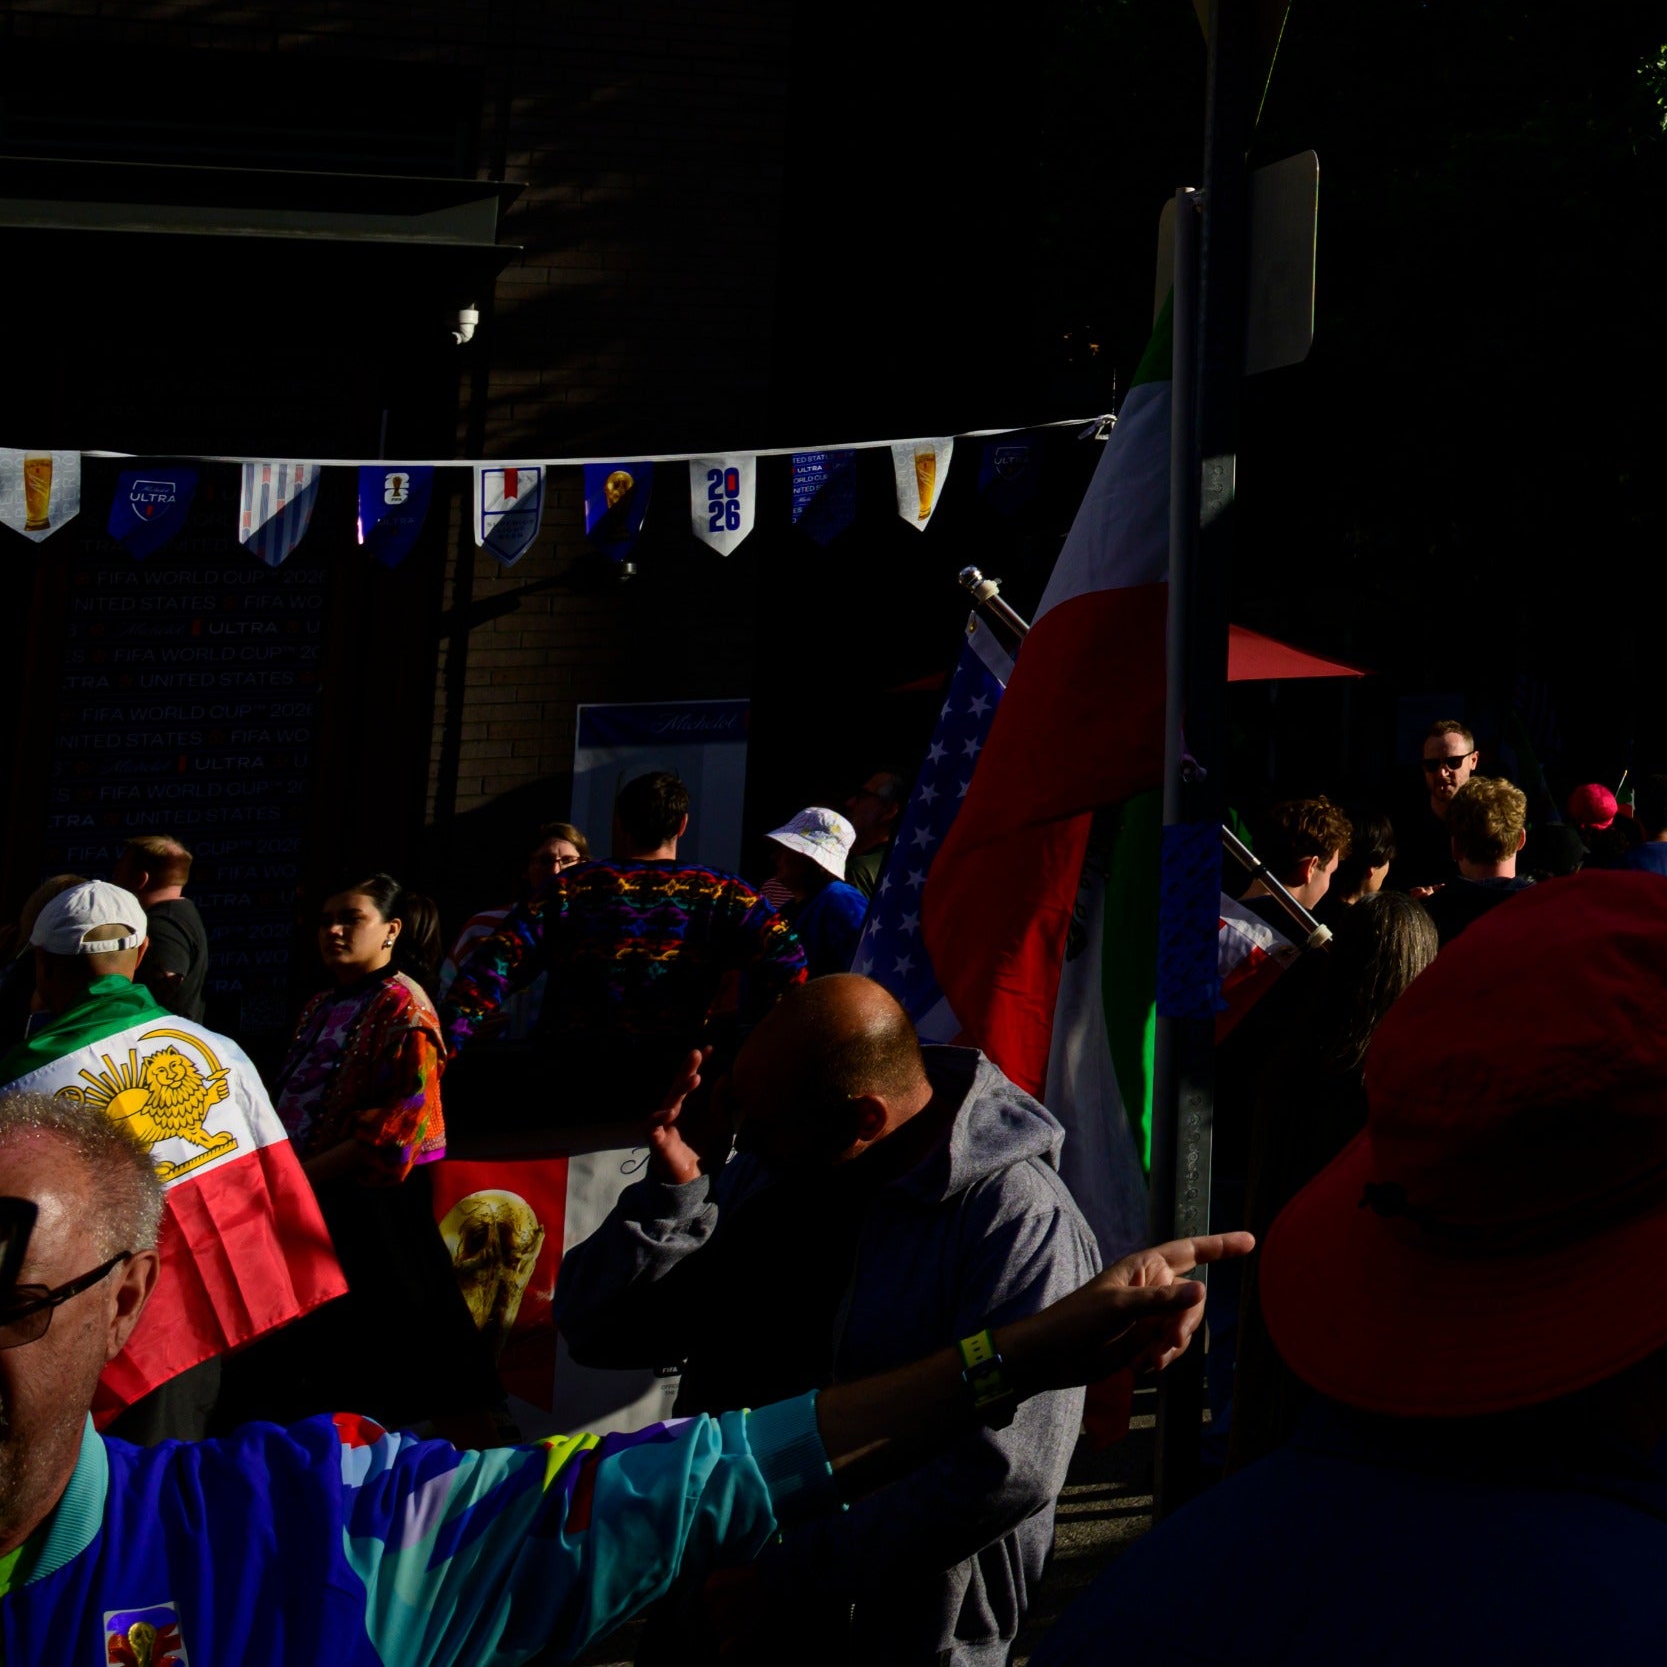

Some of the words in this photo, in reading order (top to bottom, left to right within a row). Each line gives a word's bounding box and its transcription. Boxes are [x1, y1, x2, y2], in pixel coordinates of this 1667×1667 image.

[797, 465, 823, 473] ULTRA
[707, 467, 739, 500] 20
[129, 491, 176, 503] ULTRA
[709, 499, 740, 532] 26
[143, 569, 219, 584] WORLD
[72, 596, 137, 611] NITED
[139, 595, 217, 610] STATES
[208, 620, 279, 635] ULTRA
[160, 645, 236, 661] WORLD
[139, 672, 215, 688] UNITED
[218, 670, 295, 686] STATES
[129, 705, 205, 721] WORLD
[56, 733, 121, 748] NITED
[124, 731, 203, 747] STATES
[193, 755, 265, 771] ULTRA
[146, 782, 223, 799] WORLD
[125, 809, 202, 826] UNITED
[203, 806, 281, 822] STATES
